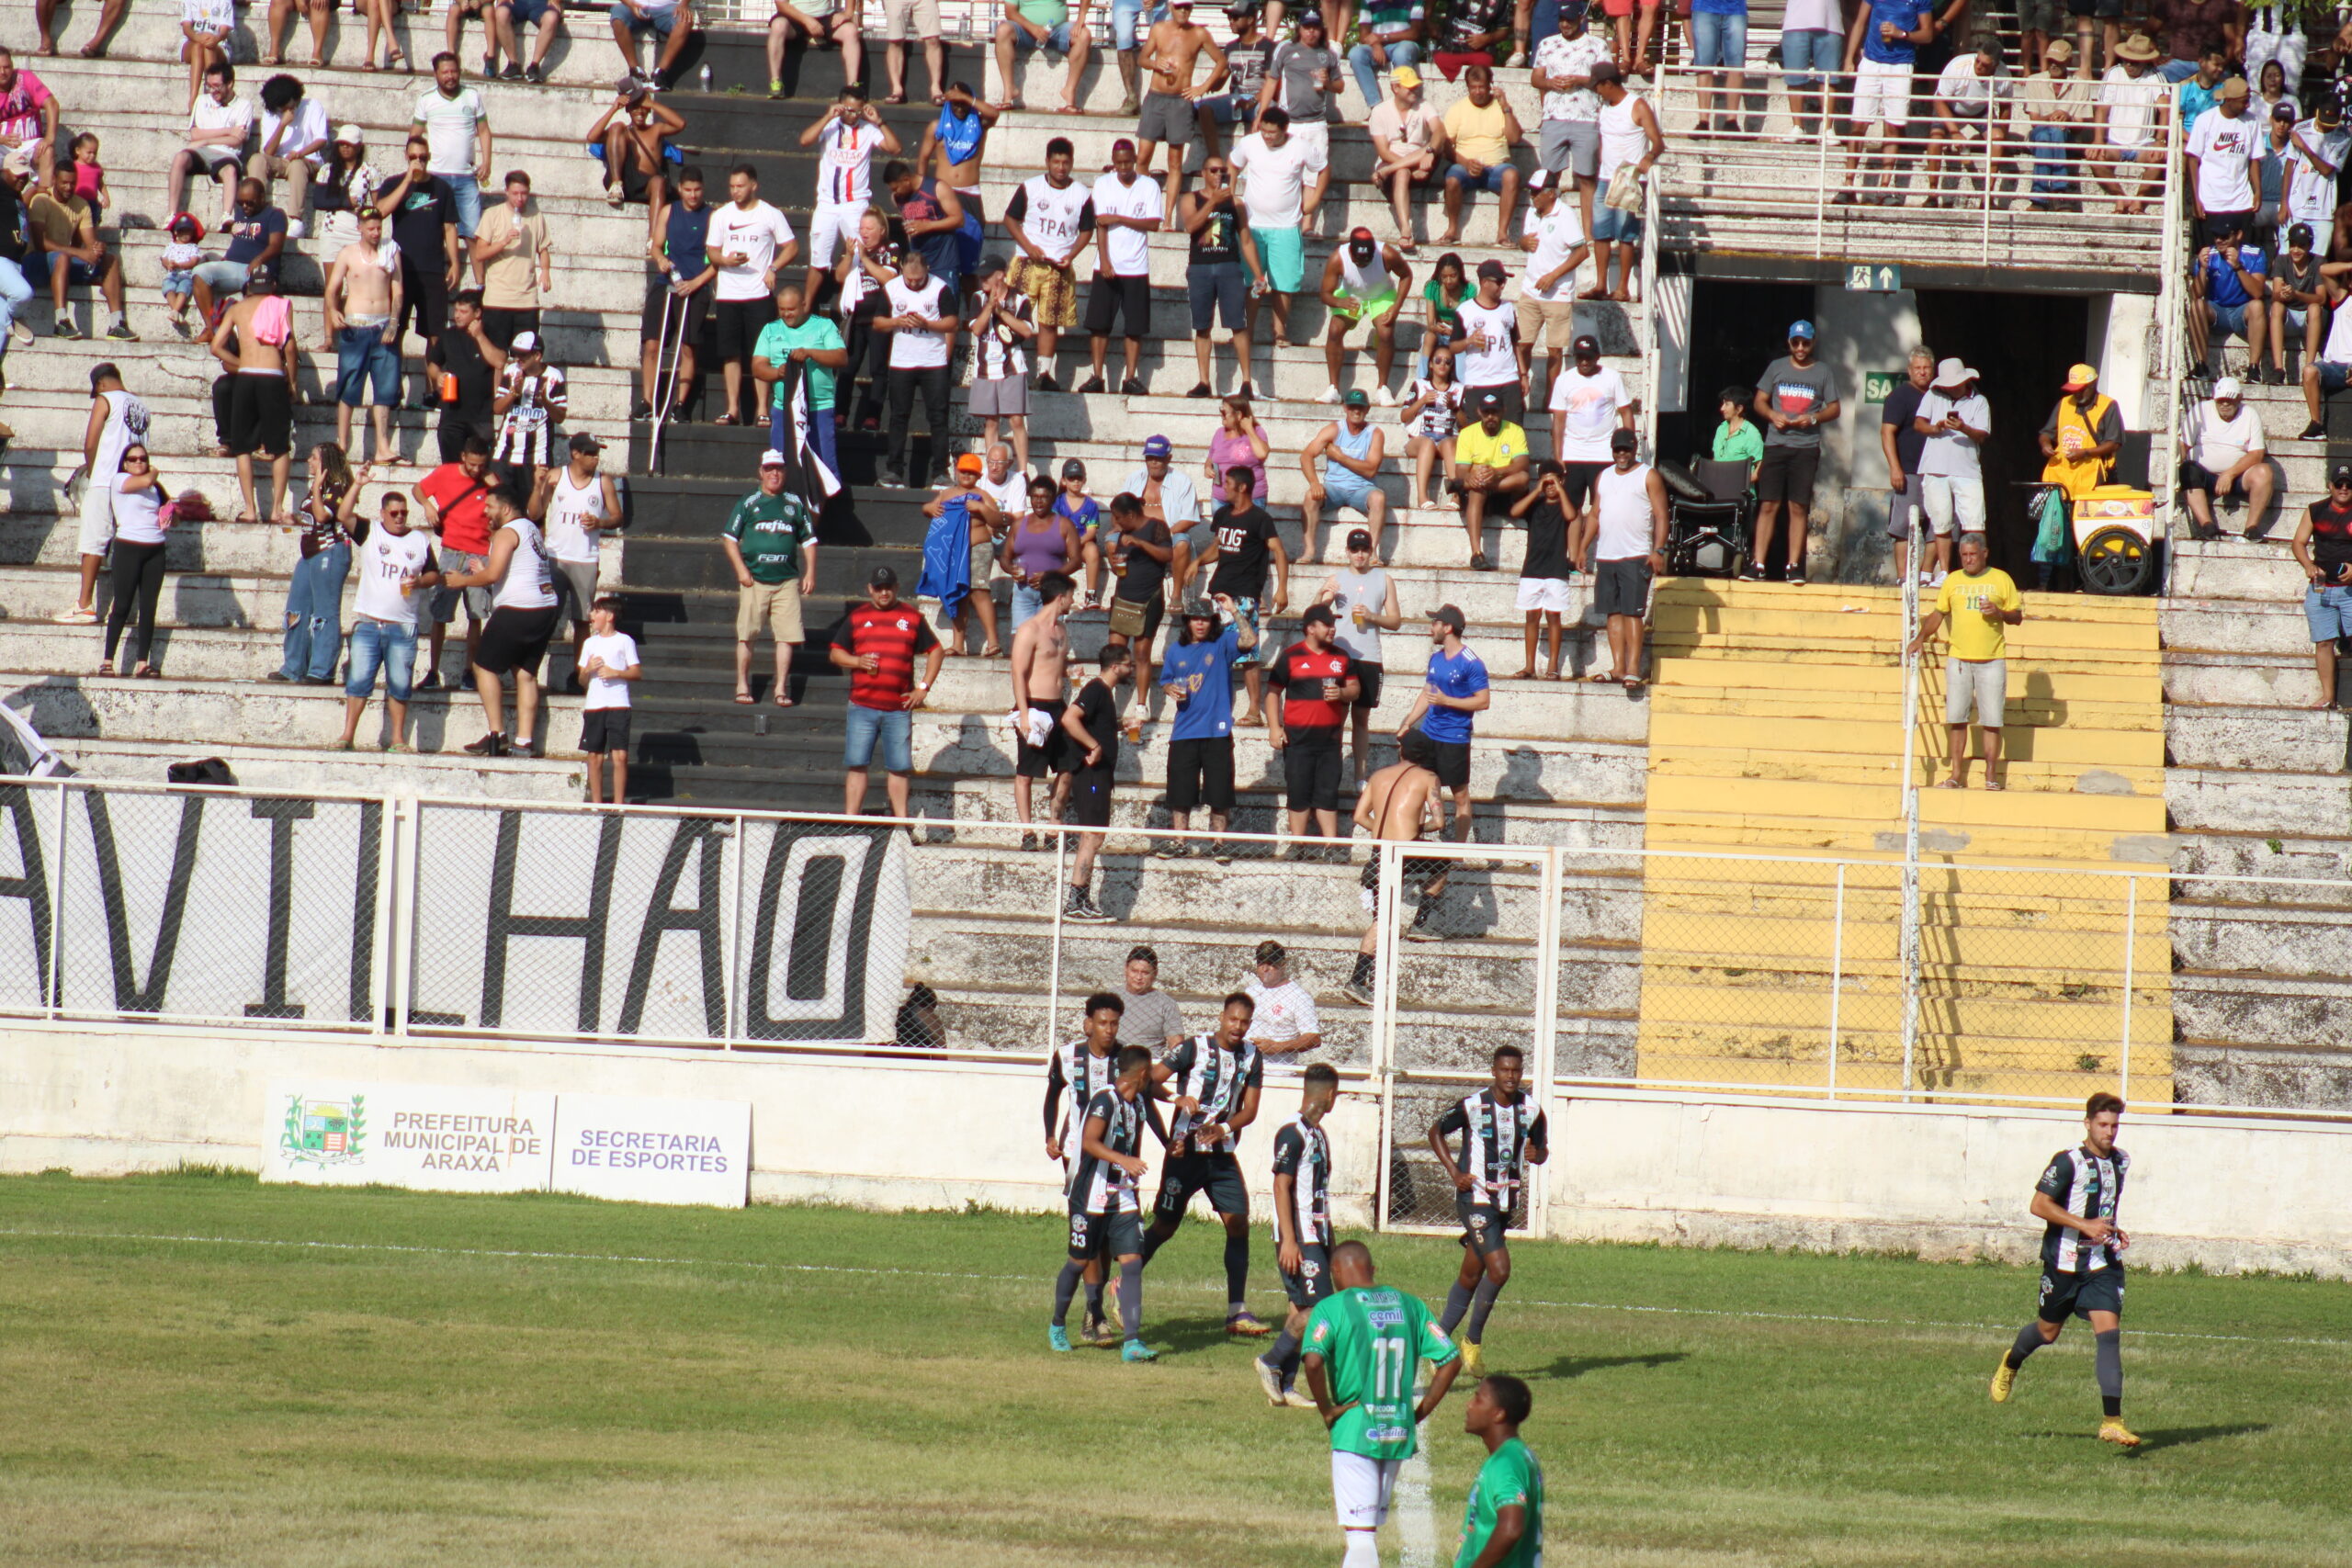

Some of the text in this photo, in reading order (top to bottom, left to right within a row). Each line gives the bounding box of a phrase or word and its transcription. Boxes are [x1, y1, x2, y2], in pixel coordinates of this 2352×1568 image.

[2218, 131, 2240, 142] NIKE
[2229, 144, 2246, 154] AIR
[1039, 217, 1067, 237] TPA
[730, 234, 759, 243] AIR
[1482, 333, 1508, 353] PA
[754, 519, 793, 533] crefisa
[380, 560, 408, 580] TPA
[394, 1112, 534, 1135] PREFEITURA
[384, 1131, 541, 1156] MUNICIPAL DE
[581, 1130, 722, 1153] SECRETARIA
[422, 1150, 500, 1172] ARAXÁ
[571, 1149, 728, 1173] DE ESPORTES
[1161, 1194, 1174, 1211] 11
[1071, 1232, 1086, 1247] 33
[1476, 1230, 1485, 1244] 5
[1306, 1280, 1316, 1294] 2
[2040, 1292, 2045, 1306] 6
[1369, 1308, 1404, 1321] cemil
[1373, 1337, 1405, 1398] 11
